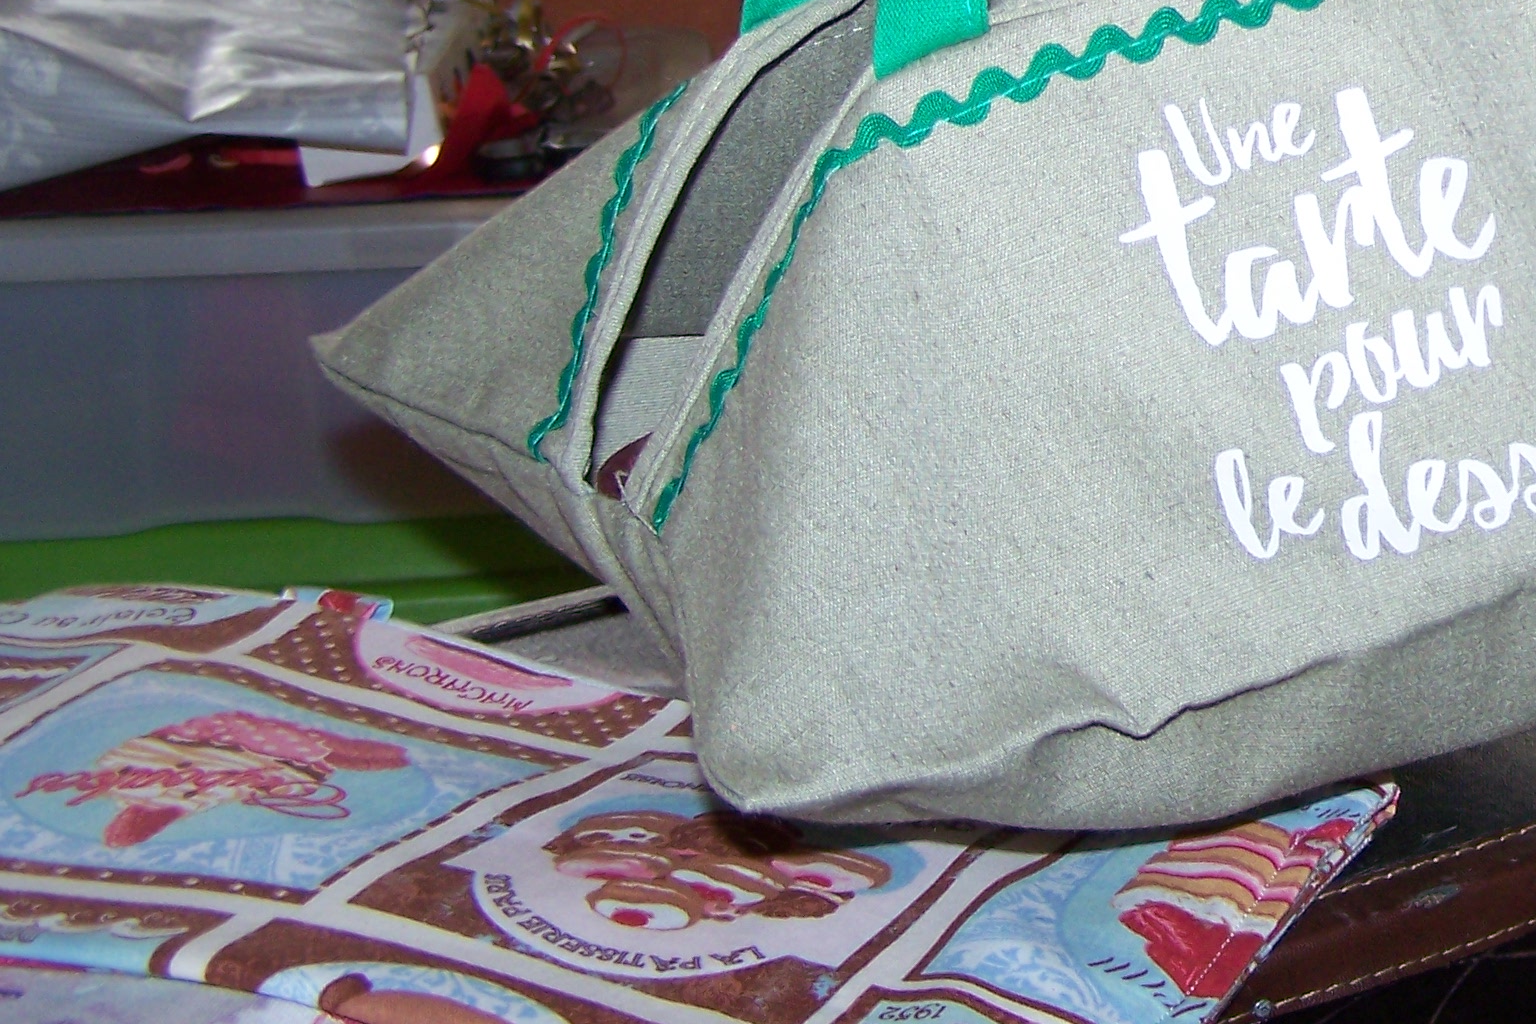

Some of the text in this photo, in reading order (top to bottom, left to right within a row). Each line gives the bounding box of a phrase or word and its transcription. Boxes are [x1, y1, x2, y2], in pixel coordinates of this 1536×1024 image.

[1164, 96, 1316, 186] Une
[1118, 87, 1496, 346] tarte
[1280, 284, 1503, 454] pour
[1215, 448, 1324, 559] le
[372, 655, 535, 712] MACARONS
[709, 944, 767, 966] LA
